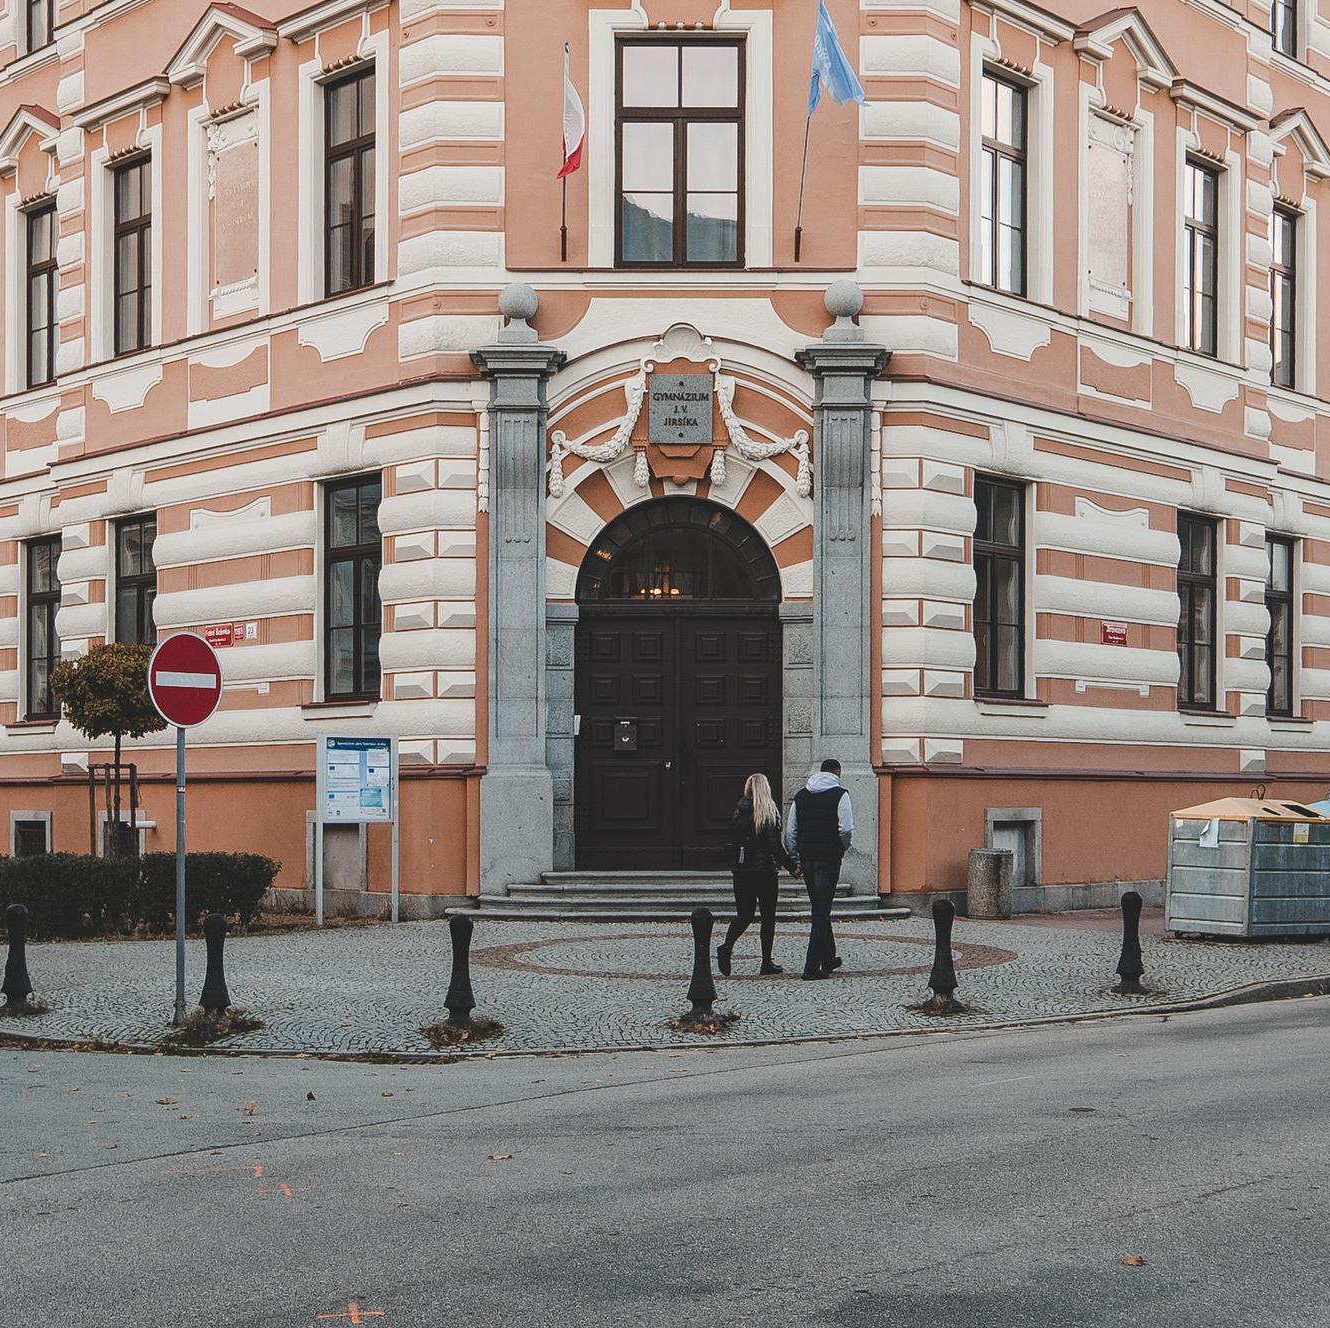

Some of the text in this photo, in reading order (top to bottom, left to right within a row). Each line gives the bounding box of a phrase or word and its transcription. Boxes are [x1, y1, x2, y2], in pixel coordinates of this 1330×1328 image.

[653, 392, 709, 401] GYMNÁZIUM
[681, 405, 688, 413] V.
[663, 417, 698, 426] JIRSÍKA
